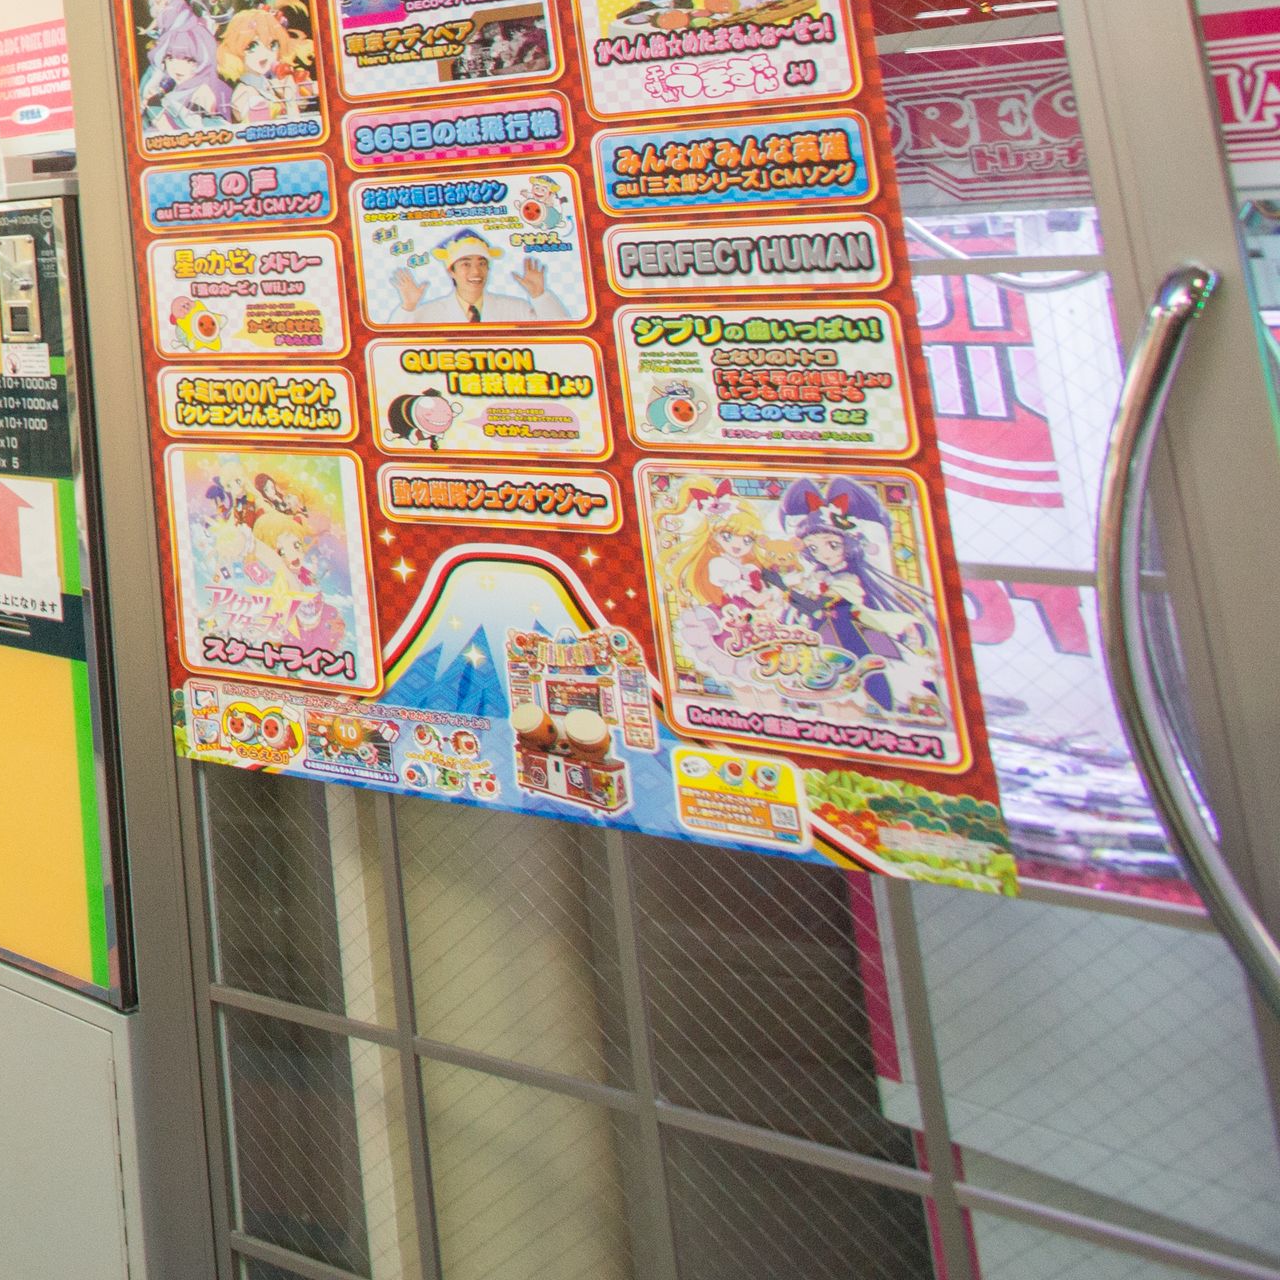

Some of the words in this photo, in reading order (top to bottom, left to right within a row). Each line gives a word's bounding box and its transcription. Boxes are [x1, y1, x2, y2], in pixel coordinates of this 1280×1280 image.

[344, 18, 475, 55] 東京テディベア
[43, 54, 60, 68] AND
[355, 106, 562, 154] 365日の紙飛行機
[189, 166, 278, 200] 海の声
[259, 251, 323, 275] メドレー
[618, 237, 754, 279] PERFECT
[757, 231, 876, 274] HUMAN
[631, 314, 885, 347] ジブリの曲いっぱい!
[400, 348, 536, 373] QUESTION
[710, 347, 839, 367] となりのトトロ
[176, 376, 337, 408] キミに100パーセント
[715, 383, 866, 403] いつも何度でも
[175, 402, 341, 430] 「クレヨンしんちゃん」より
[830, 408, 869, 425] など
[389, 476, 608, 519] 動物戦隊ジュウオウジャー
[203, 637, 357, 681] スタートライン!
[339, 723, 357, 741] 10
[236, 745, 290, 765] もらえる!
